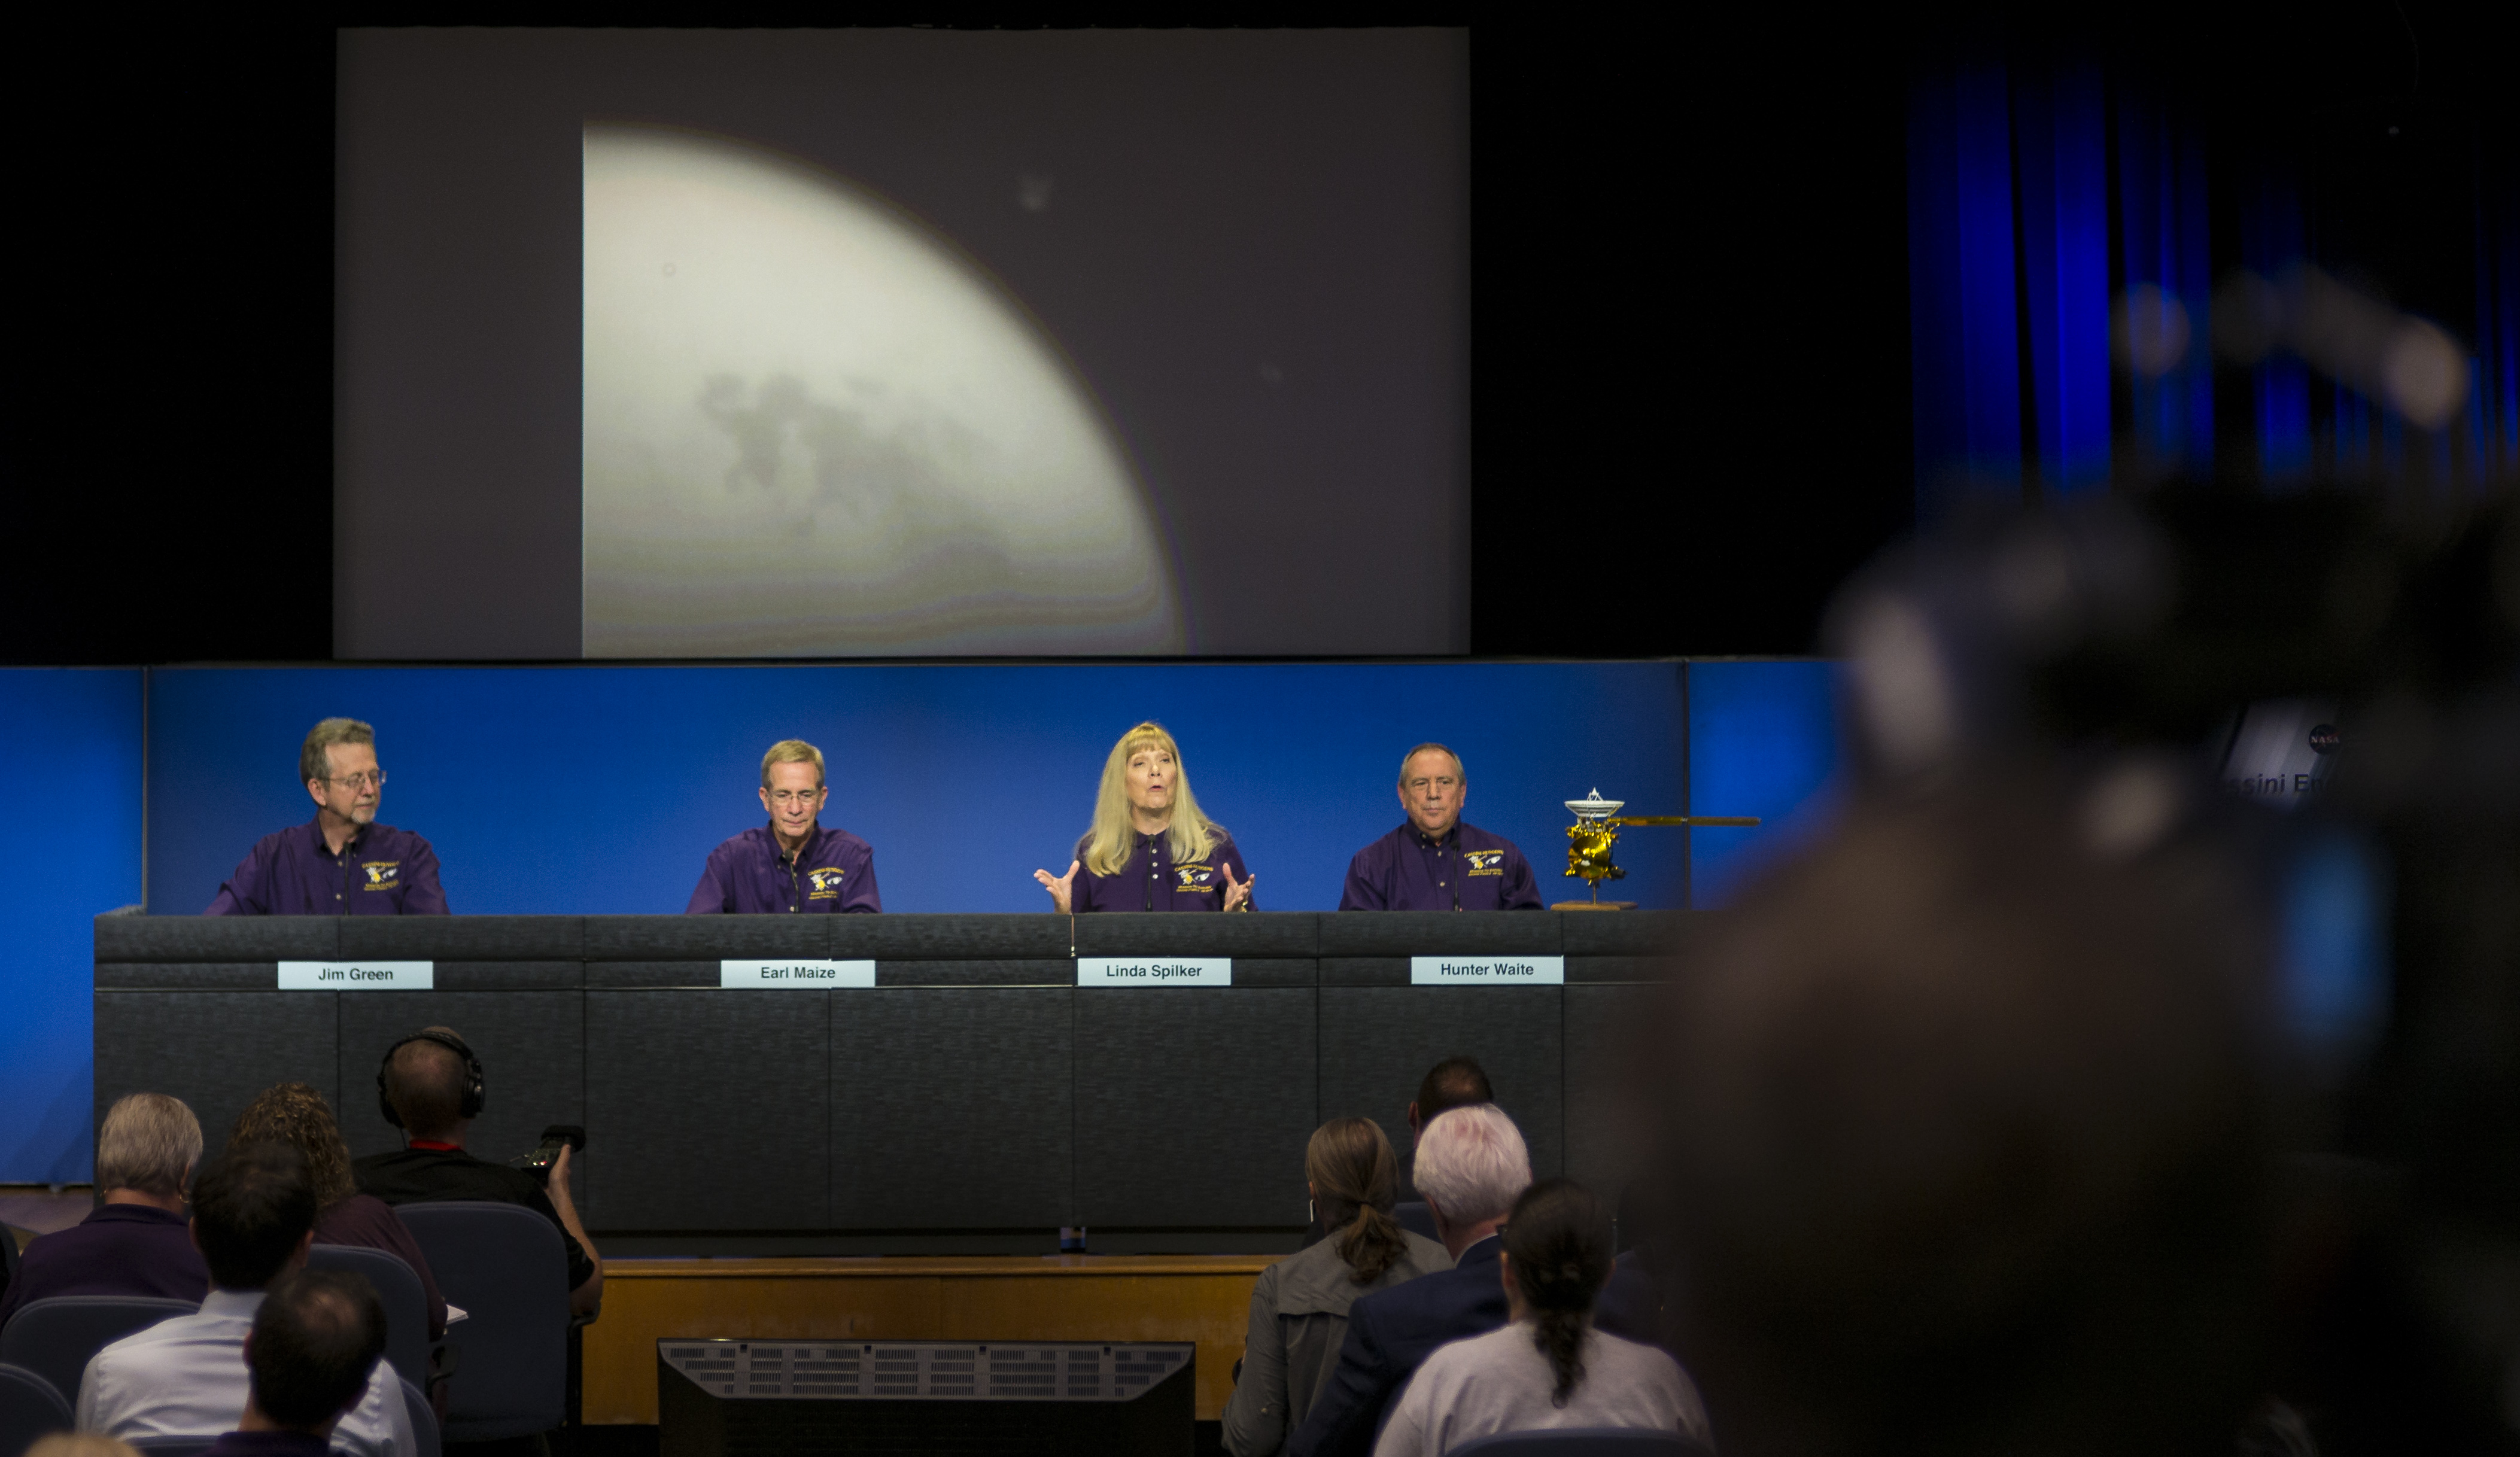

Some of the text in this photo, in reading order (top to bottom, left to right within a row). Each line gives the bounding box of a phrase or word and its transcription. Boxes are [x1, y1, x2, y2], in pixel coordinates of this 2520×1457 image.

[2224, 773, 2285, 795] ssini
[318, 968, 393, 980] Jim Green
[761, 967, 835, 978] Earl Maize
[1107, 965, 1202, 980] Linda Spilker
[1441, 963, 1534, 975] Hunter Waite
